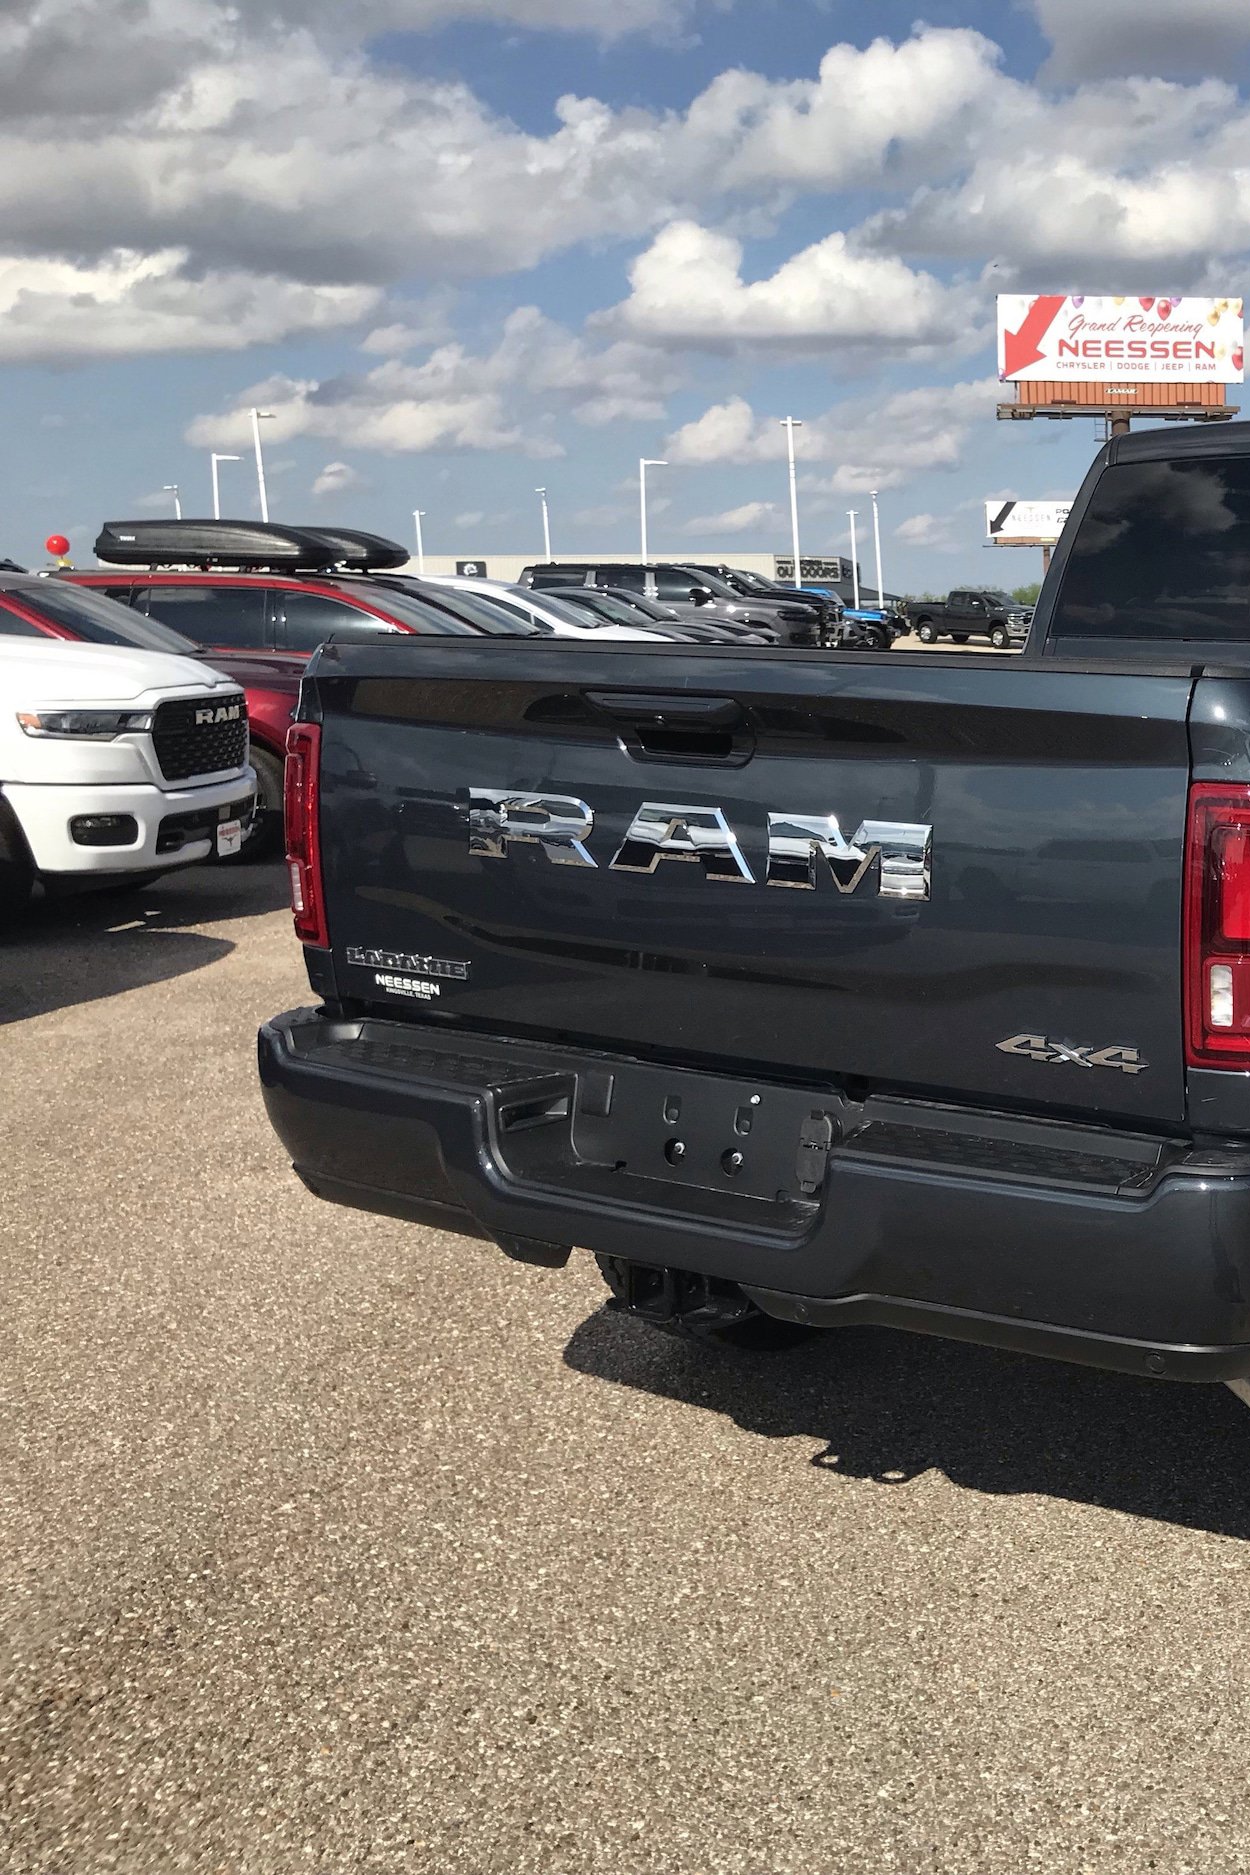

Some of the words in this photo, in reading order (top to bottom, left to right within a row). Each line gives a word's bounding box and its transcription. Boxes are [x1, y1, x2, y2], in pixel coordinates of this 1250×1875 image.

[1068, 314, 1122, 340] Grand
[1123, 314, 1204, 338] Reopening
[1058, 339, 1216, 359] NEESSEN
[1056, 361, 1106, 370] CHRYSLER
[1117, 362, 1150, 370] DODGE
[1161, 363, 1184, 371] JEEP
[1195, 363, 1216, 371] RAM
[777, 565, 839, 578] OUDOORS
[195, 705, 240, 726] RAM
[468, 786, 934, 901] RAM
[375, 973, 441, 996] NEESSEN
